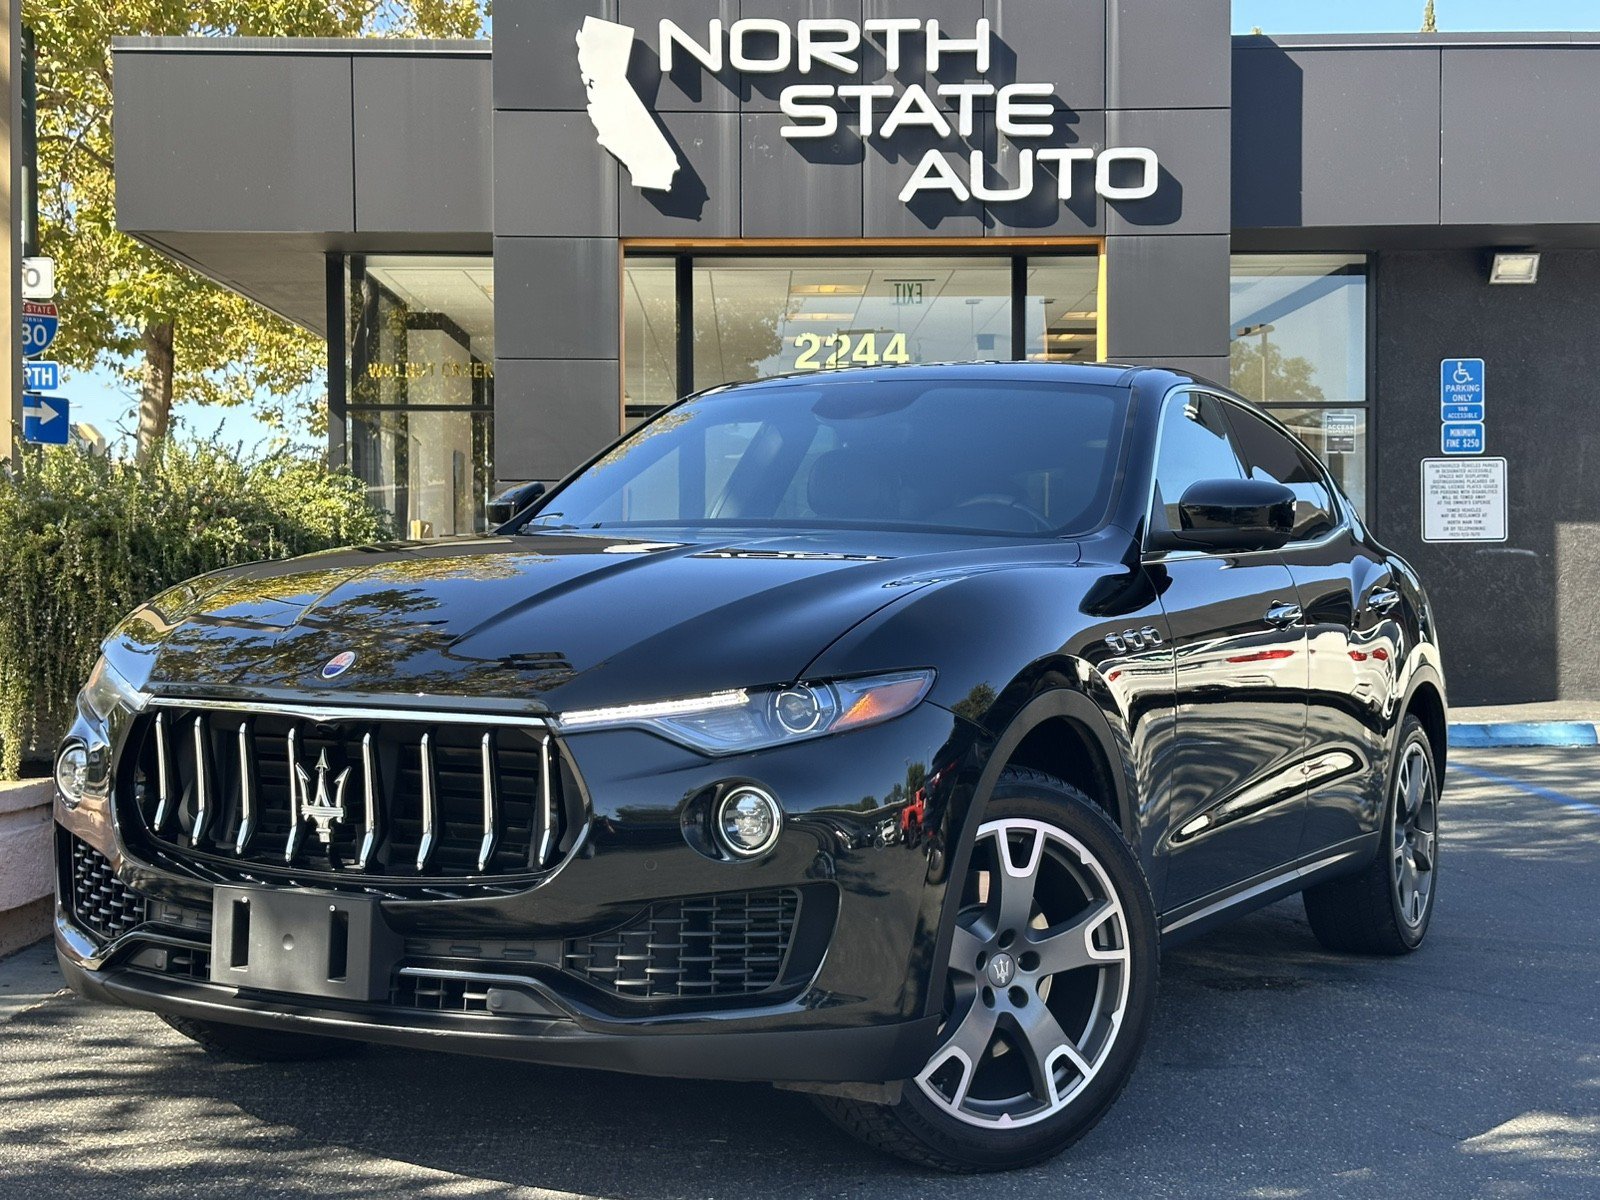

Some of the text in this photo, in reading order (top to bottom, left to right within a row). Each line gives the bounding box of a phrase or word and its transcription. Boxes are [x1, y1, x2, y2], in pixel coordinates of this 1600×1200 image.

[659, 18, 989, 74] NORTH
[780, 83, 1054, 138] STATE
[899, 148, 1160, 202] AUTO
[794, 332, 910, 370] 2244
[1445, 384, 1480, 392] PARKING
[1452, 394, 1473, 402] ONLY
[1446, 438, 1480, 448] FINE $250
[1449, 428, 1476, 437] MINIMUM
